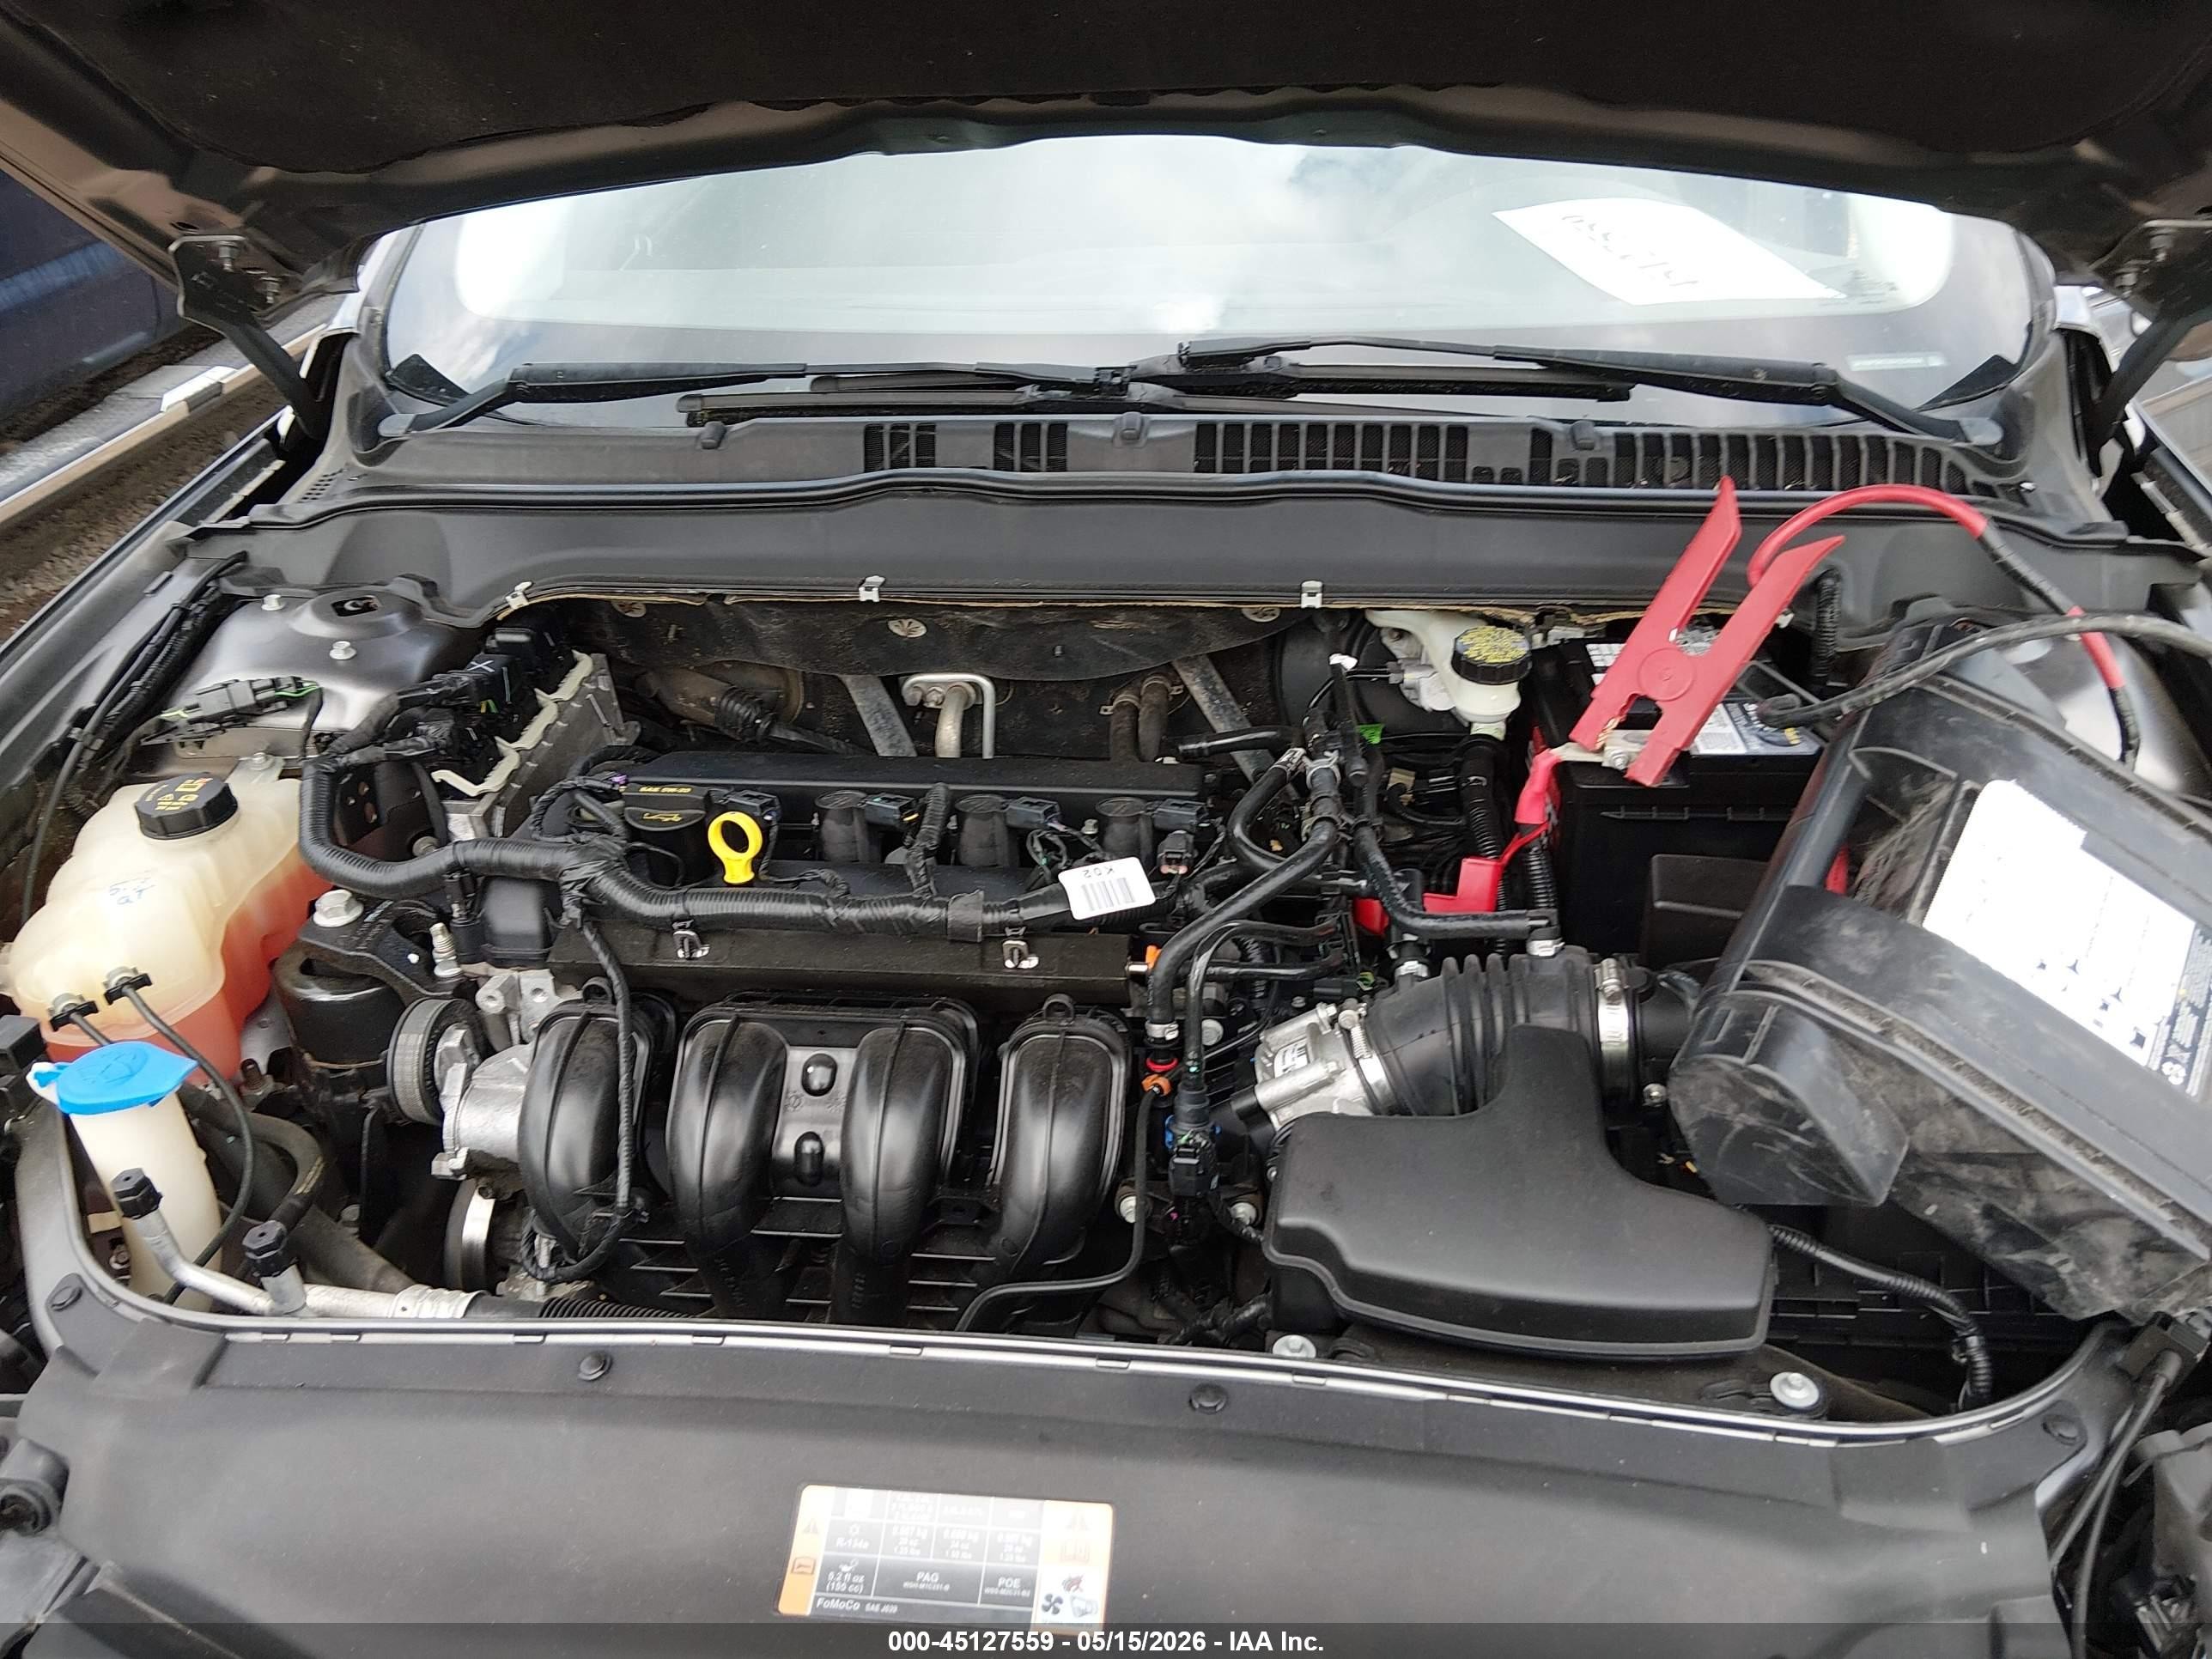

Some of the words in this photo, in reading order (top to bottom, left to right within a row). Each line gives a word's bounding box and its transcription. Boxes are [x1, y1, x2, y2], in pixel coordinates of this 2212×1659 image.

[916, 1571, 939, 1583] PAG
[998, 1577, 1022, 1589] POE
[816, 1597, 860, 1611] FoMoCo
